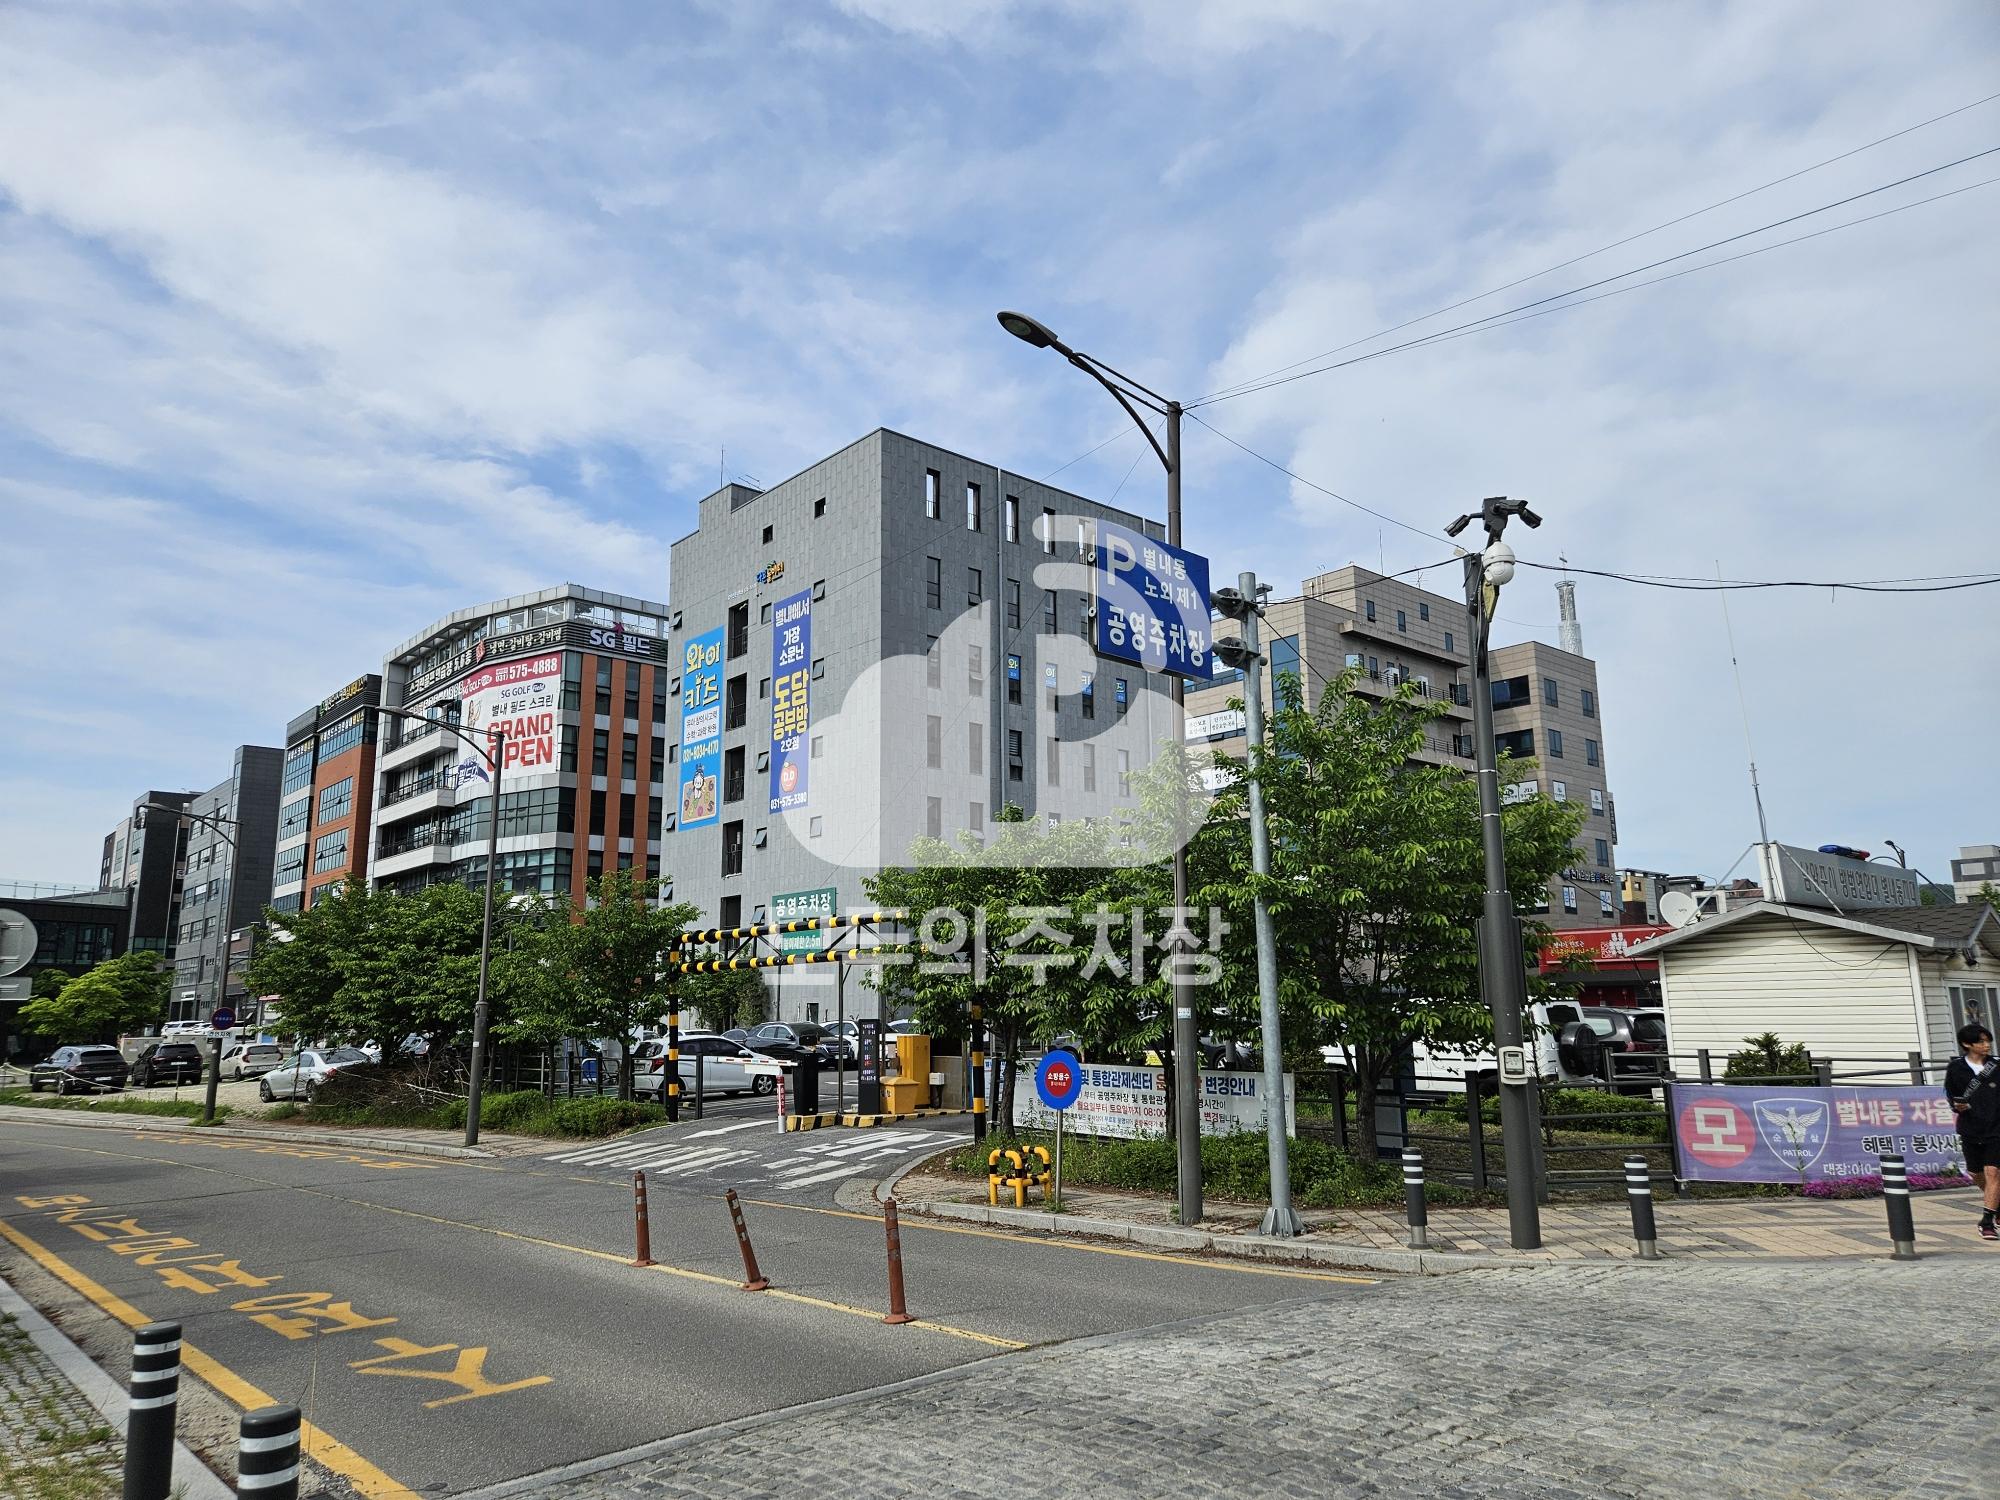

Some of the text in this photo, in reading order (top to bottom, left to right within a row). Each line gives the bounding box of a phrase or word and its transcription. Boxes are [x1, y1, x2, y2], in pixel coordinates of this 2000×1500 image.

[1106, 533, 1137, 586] P
[1143, 546, 1187, 581] 별내동
[775, 597, 810, 627] 별내에서
[589, 628, 651, 656] SG 필드
[783, 625, 801, 647] 가장
[1107, 605, 1205, 667] 공영주차장
[686, 641, 721, 675] 와이
[779, 642, 805, 666] 소문난
[509, 658, 558, 680] 575-4888
[501, 688, 511, 698] SG
[512, 685, 531, 697] GOLF
[774, 668, 810, 711] 도담
[492, 694, 554, 717] 별내 필드 스크린
[487, 713, 553, 744] GRAND
[773, 704, 810, 741] 공부방
[487, 736, 553, 773] OPEN
[780, 735, 800, 753] 2호점
[775, 892, 832, 917] 공영주차장
[1092, 1070, 1153, 1090] 통합관제센터
[1205, 1076, 1256, 1097] 변경안내
[1077, 1100, 1108, 1113] 월요일부터
[1109, 1104, 1141, 1116] 토요일까지
[1097, 1091, 1129, 1103] 공영주차장
[1131, 1094, 1138, 1103] 및
[1836, 1099, 1904, 1127] 별내동
[1691, 1107, 1746, 1153] 모
[1782, 1149, 1815, 1158] PATROL
[1862, 1135, 1895, 1154] 혜택
